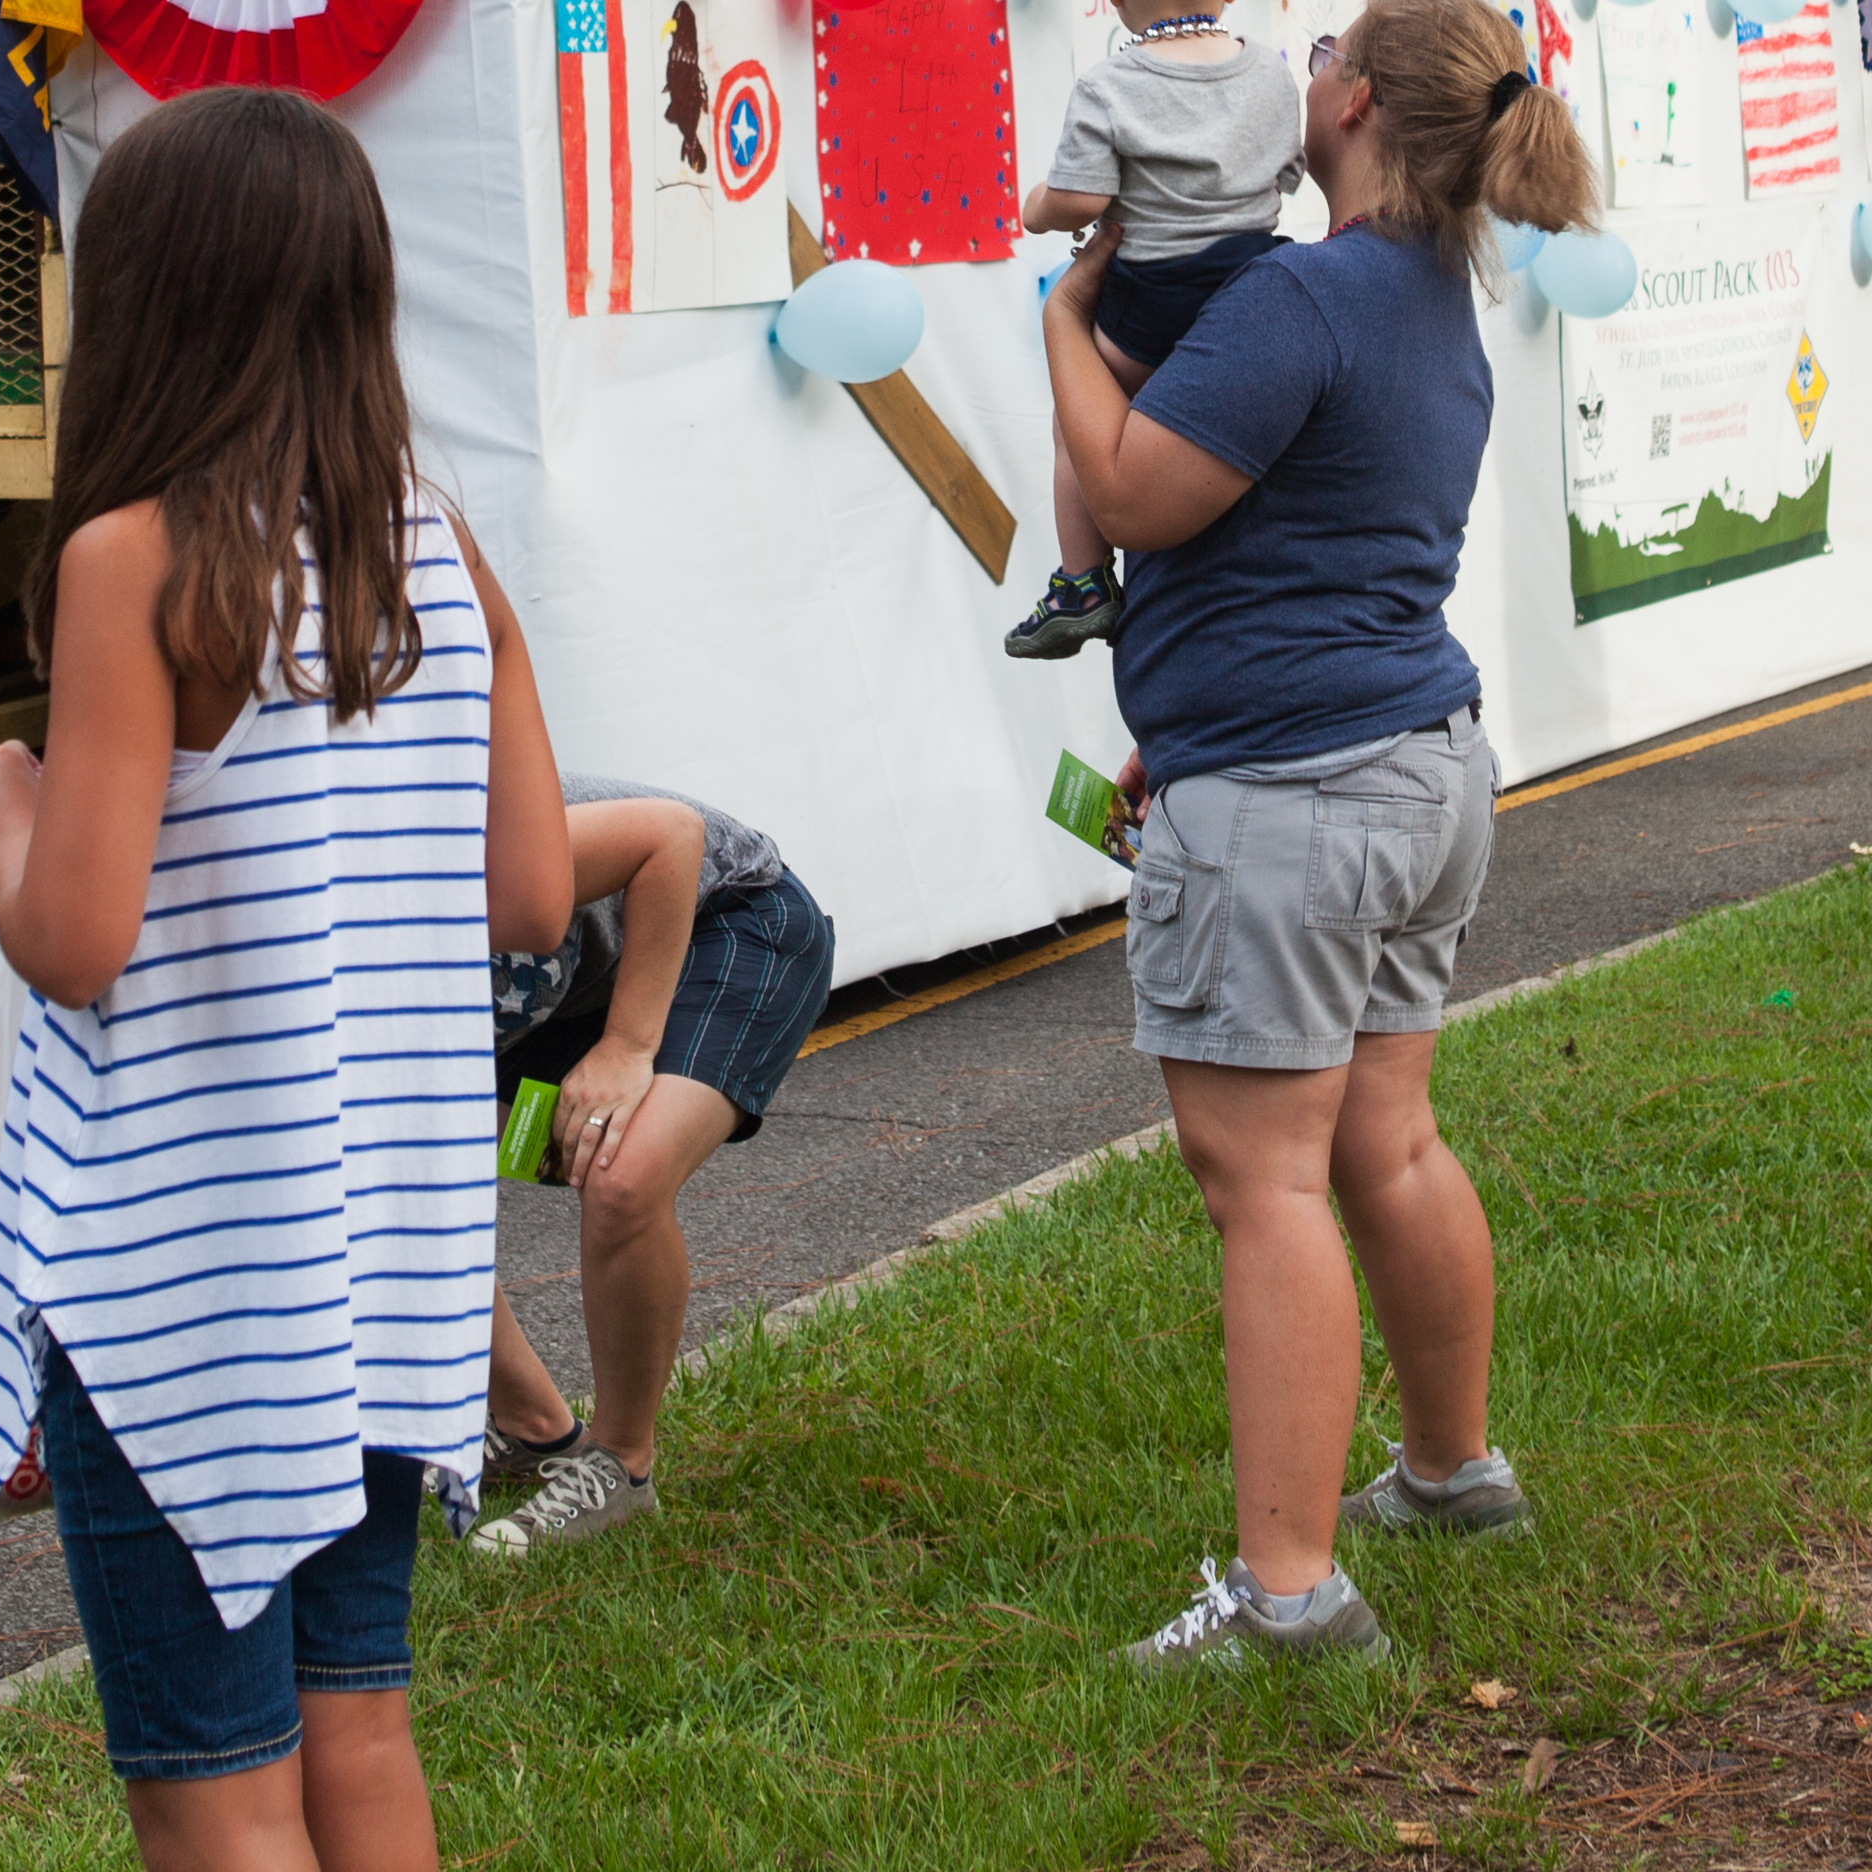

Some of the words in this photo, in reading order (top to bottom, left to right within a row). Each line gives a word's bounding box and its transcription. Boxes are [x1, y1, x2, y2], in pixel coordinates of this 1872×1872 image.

[857, 141, 965, 209] USA
[1641, 267, 1708, 311] SCOUT
[1713, 259, 1762, 301] PACK
[1765, 248, 1800, 291] 103
